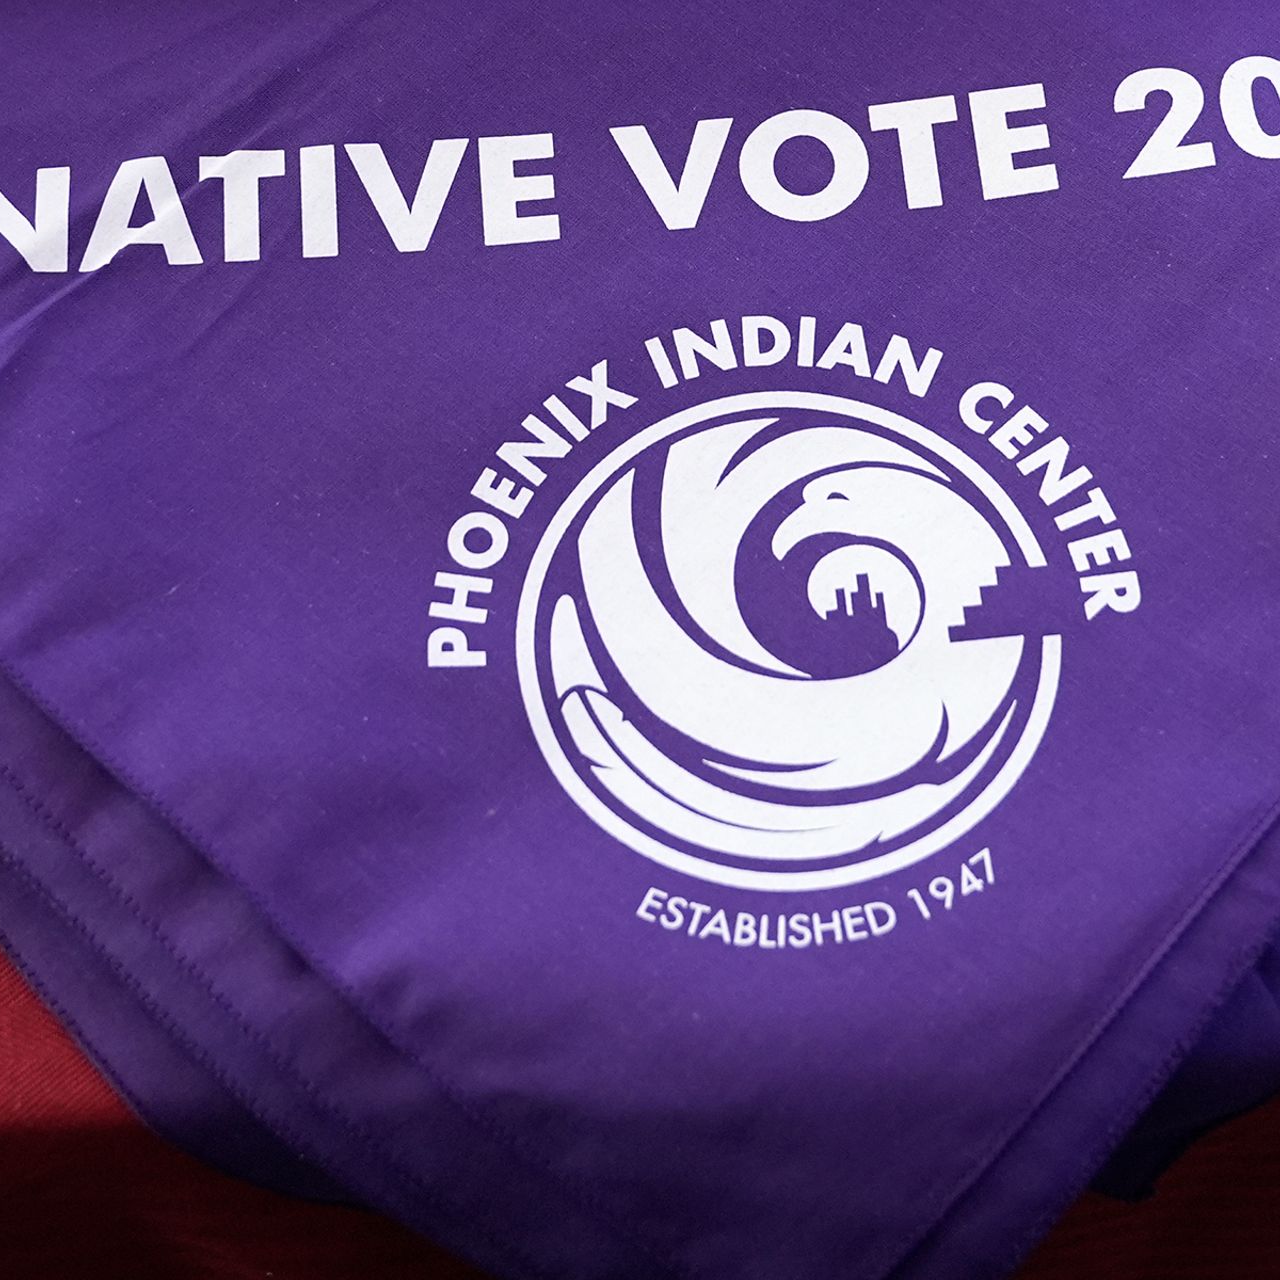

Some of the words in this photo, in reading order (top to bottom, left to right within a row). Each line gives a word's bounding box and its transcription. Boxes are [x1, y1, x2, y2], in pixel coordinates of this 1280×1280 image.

[608, 83, 1060, 231] VOTE
[426, 358, 638, 668] PHOENIX
[644, 315, 944, 398] INDIAN
[958, 380, 1142, 621] CENTER
[635, 886, 897, 948] ESTABLISHED
[906, 848, 997, 920] 1947
